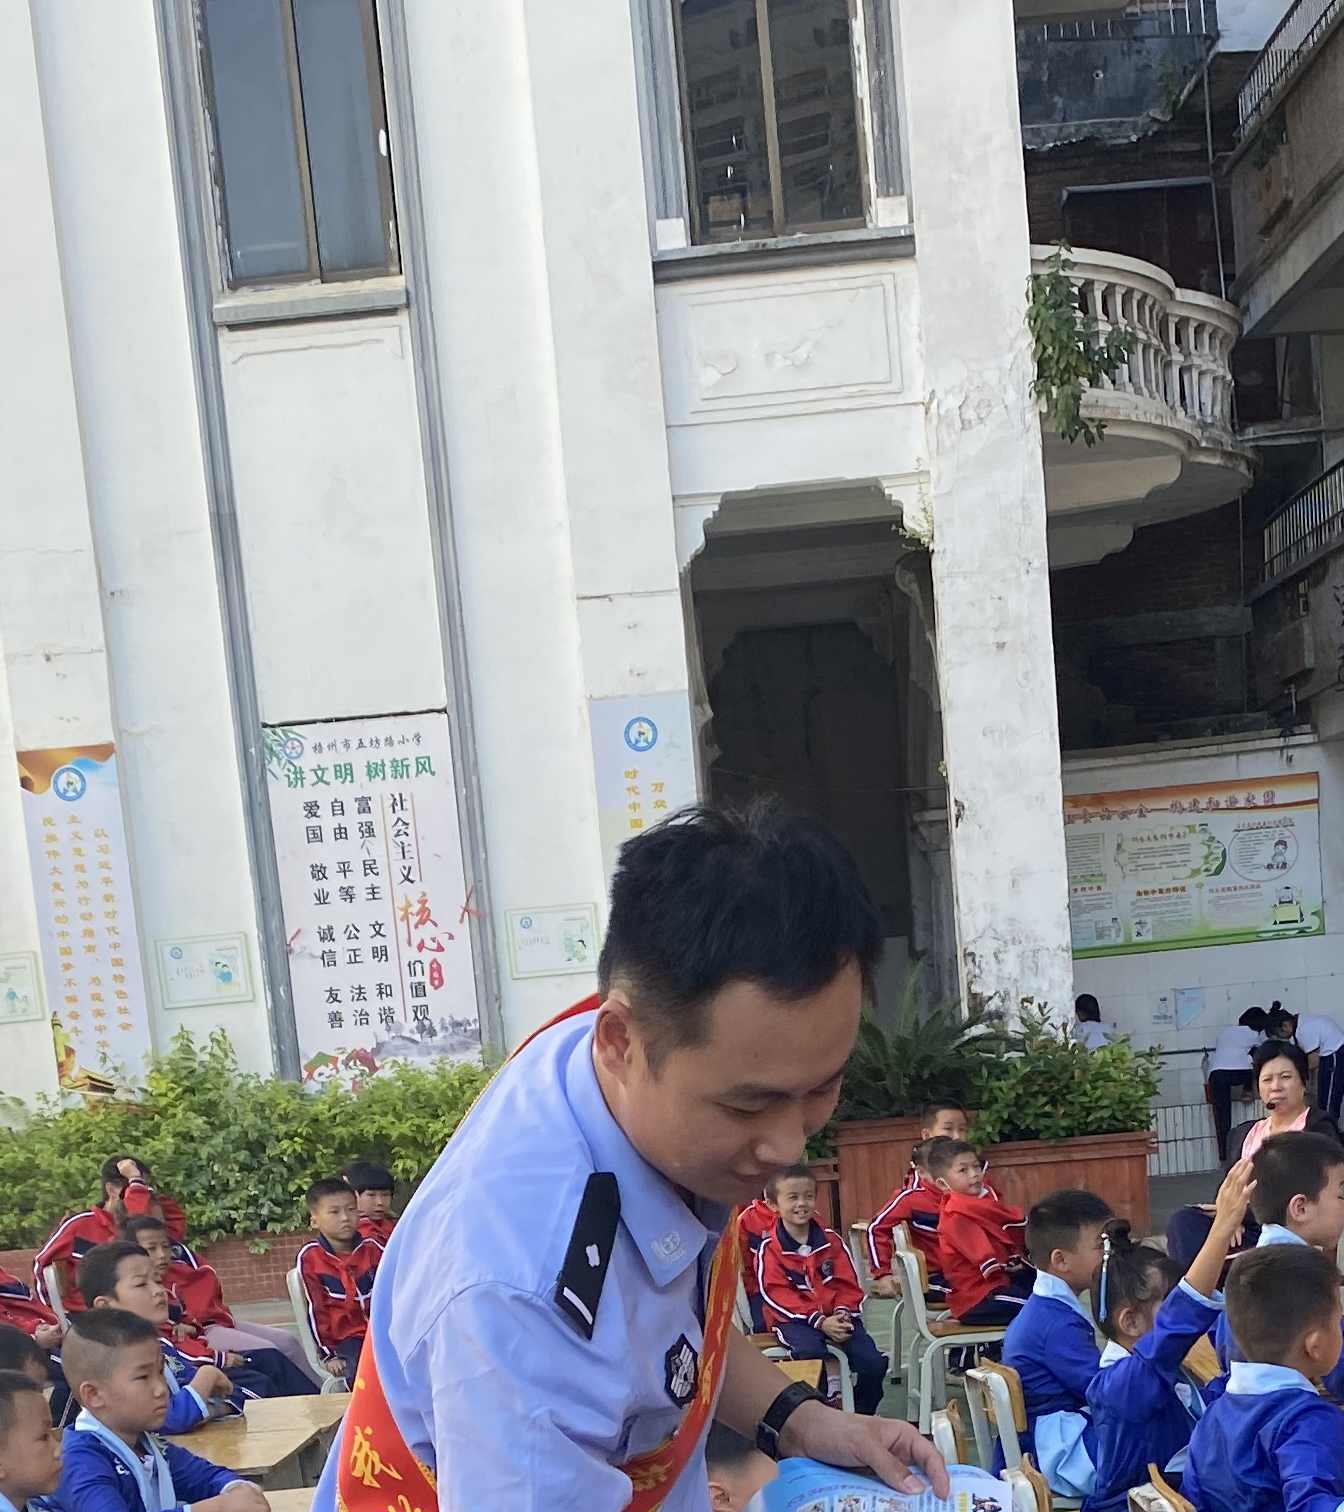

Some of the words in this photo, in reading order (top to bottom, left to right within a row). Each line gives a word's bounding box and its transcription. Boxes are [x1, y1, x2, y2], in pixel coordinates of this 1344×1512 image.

[283, 761, 354, 789] 讲文明
[365, 755, 436, 782] 树新风
[303, 800, 323, 844] 爱国
[330, 800, 350, 841] 自由
[355, 795, 376, 840] 富强
[309, 862, 331, 906] 敬业
[336, 860, 356, 903] 平等
[362, 859, 383, 902] 民主
[388, 792, 416, 886] 社会主义
[407, 960, 430, 1021] 价值观
[317, 924, 337, 968] 诚信
[343, 923, 364, 965] 公正
[368, 920, 389, 963] 文明
[325, 986, 345, 1029] 友善
[350, 984, 370, 1027] 法治
[375, 983, 396, 1026] 和谐
